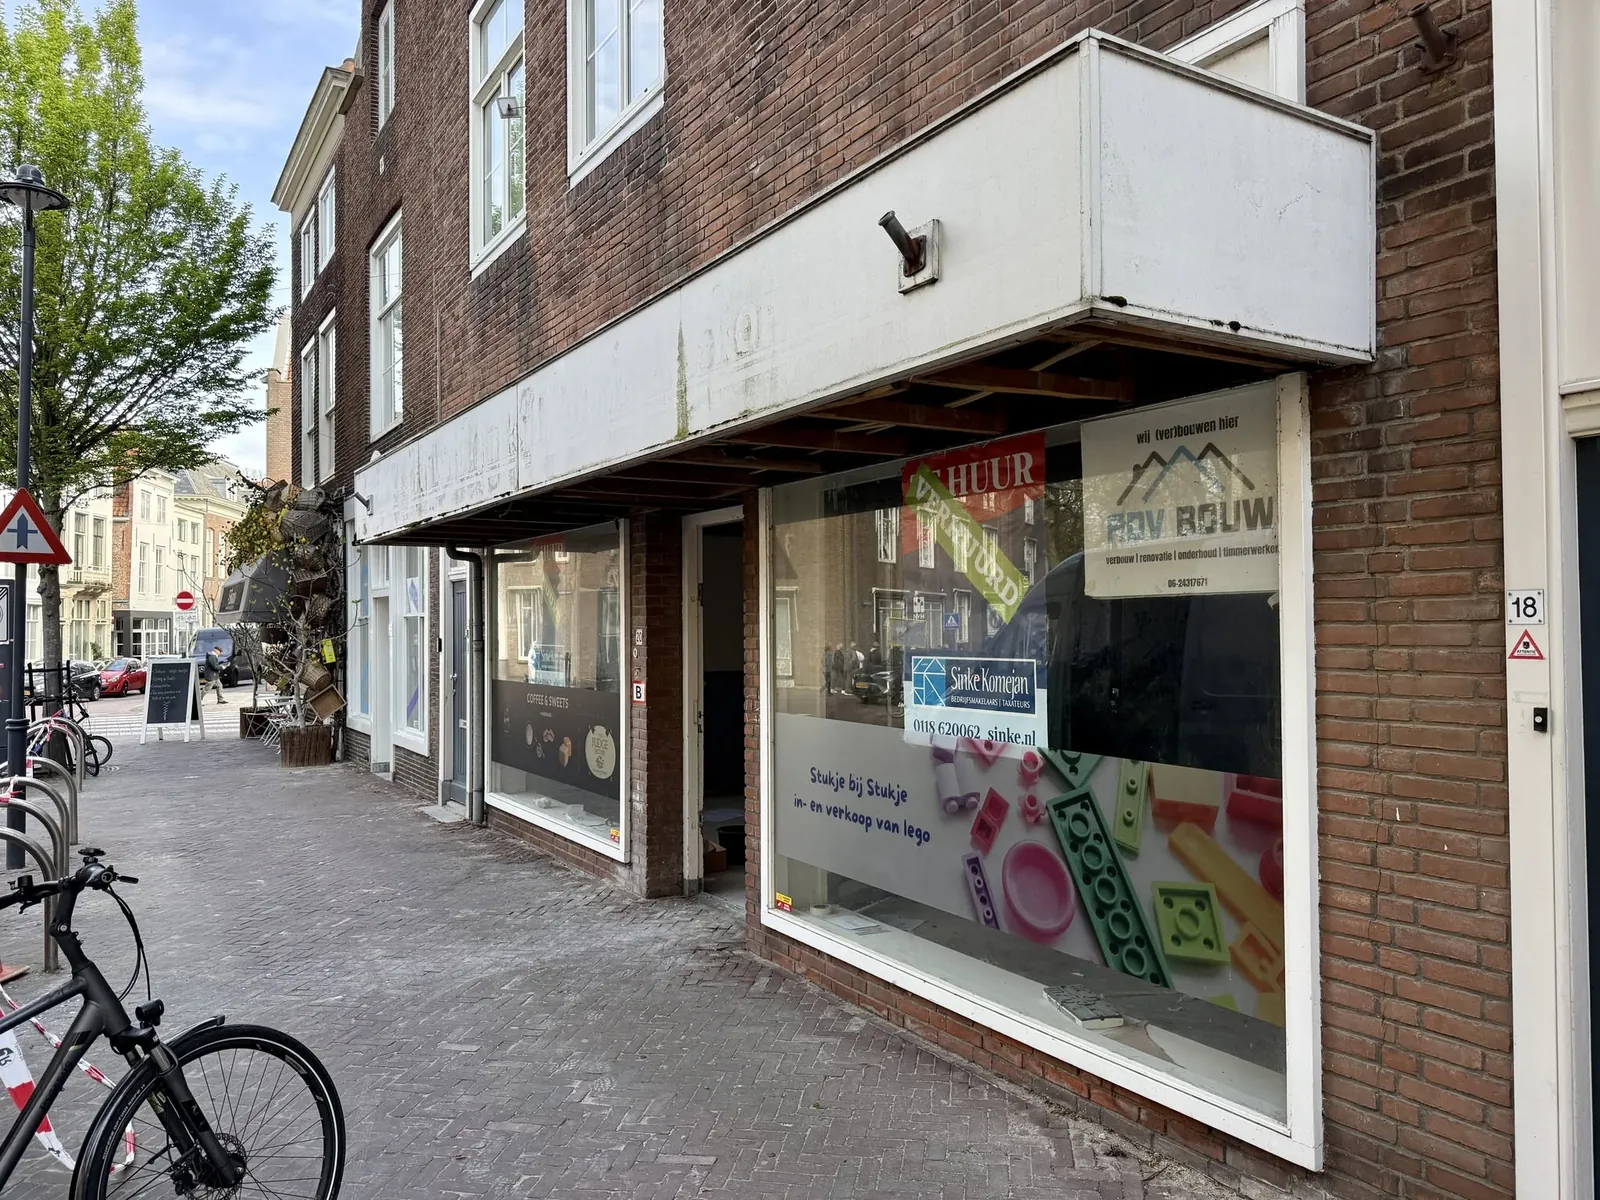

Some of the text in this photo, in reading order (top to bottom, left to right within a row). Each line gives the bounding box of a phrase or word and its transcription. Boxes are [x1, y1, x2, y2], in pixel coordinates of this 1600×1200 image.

[1136, 416, 1240, 444] wij (ver)bouwen hier
[948, 452, 1034, 496] HUUR
[1176, 496, 1274, 537] BOUW
[1106, 555, 1135, 565] verbouw
[1140, 551, 1173, 563] renovatie
[1178, 547, 1218, 560] onderhoud
[1168, 578, 1208, 588] 06-24317671
[1511, 596, 1538, 618] 18
[635, 685, 642, 699] B
[950, 666, 1029, 700] Sinke Komejan
[526, 693, 544, 706] COFFEE
[549, 695, 569, 709] SWEETS
[951, 695, 998, 707] BEDRIJFSMAKELAARS
[1002, 699, 1031, 709] TAXATEURS
[913, 719, 1037, 747] 0118 620062 sinke.nl
[810, 767, 908, 806] Stukje bij Stukje
[794, 793, 931, 846] in- en verkoop van lego
